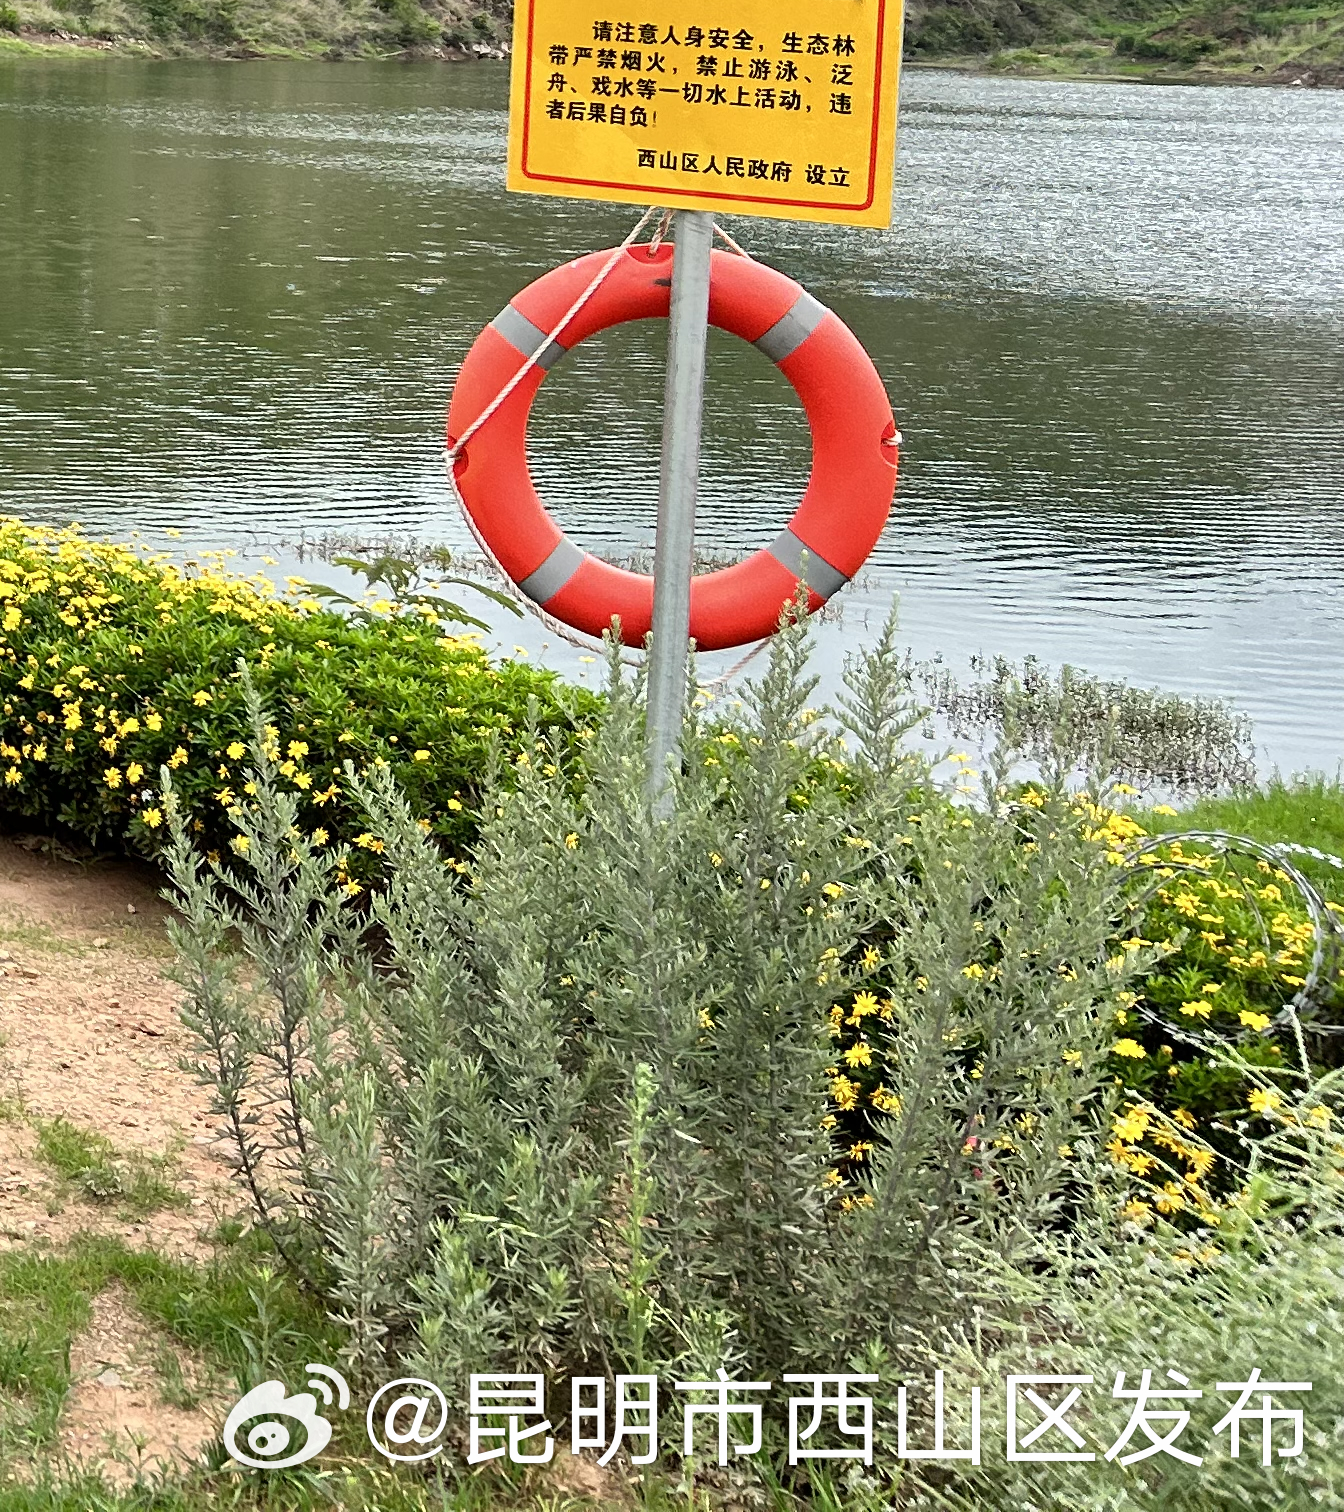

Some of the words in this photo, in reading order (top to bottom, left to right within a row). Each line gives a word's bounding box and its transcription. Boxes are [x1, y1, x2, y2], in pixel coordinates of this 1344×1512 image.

[637, 148, 792, 183] 西山区人民政府
[804, 162, 851, 188] 设立
